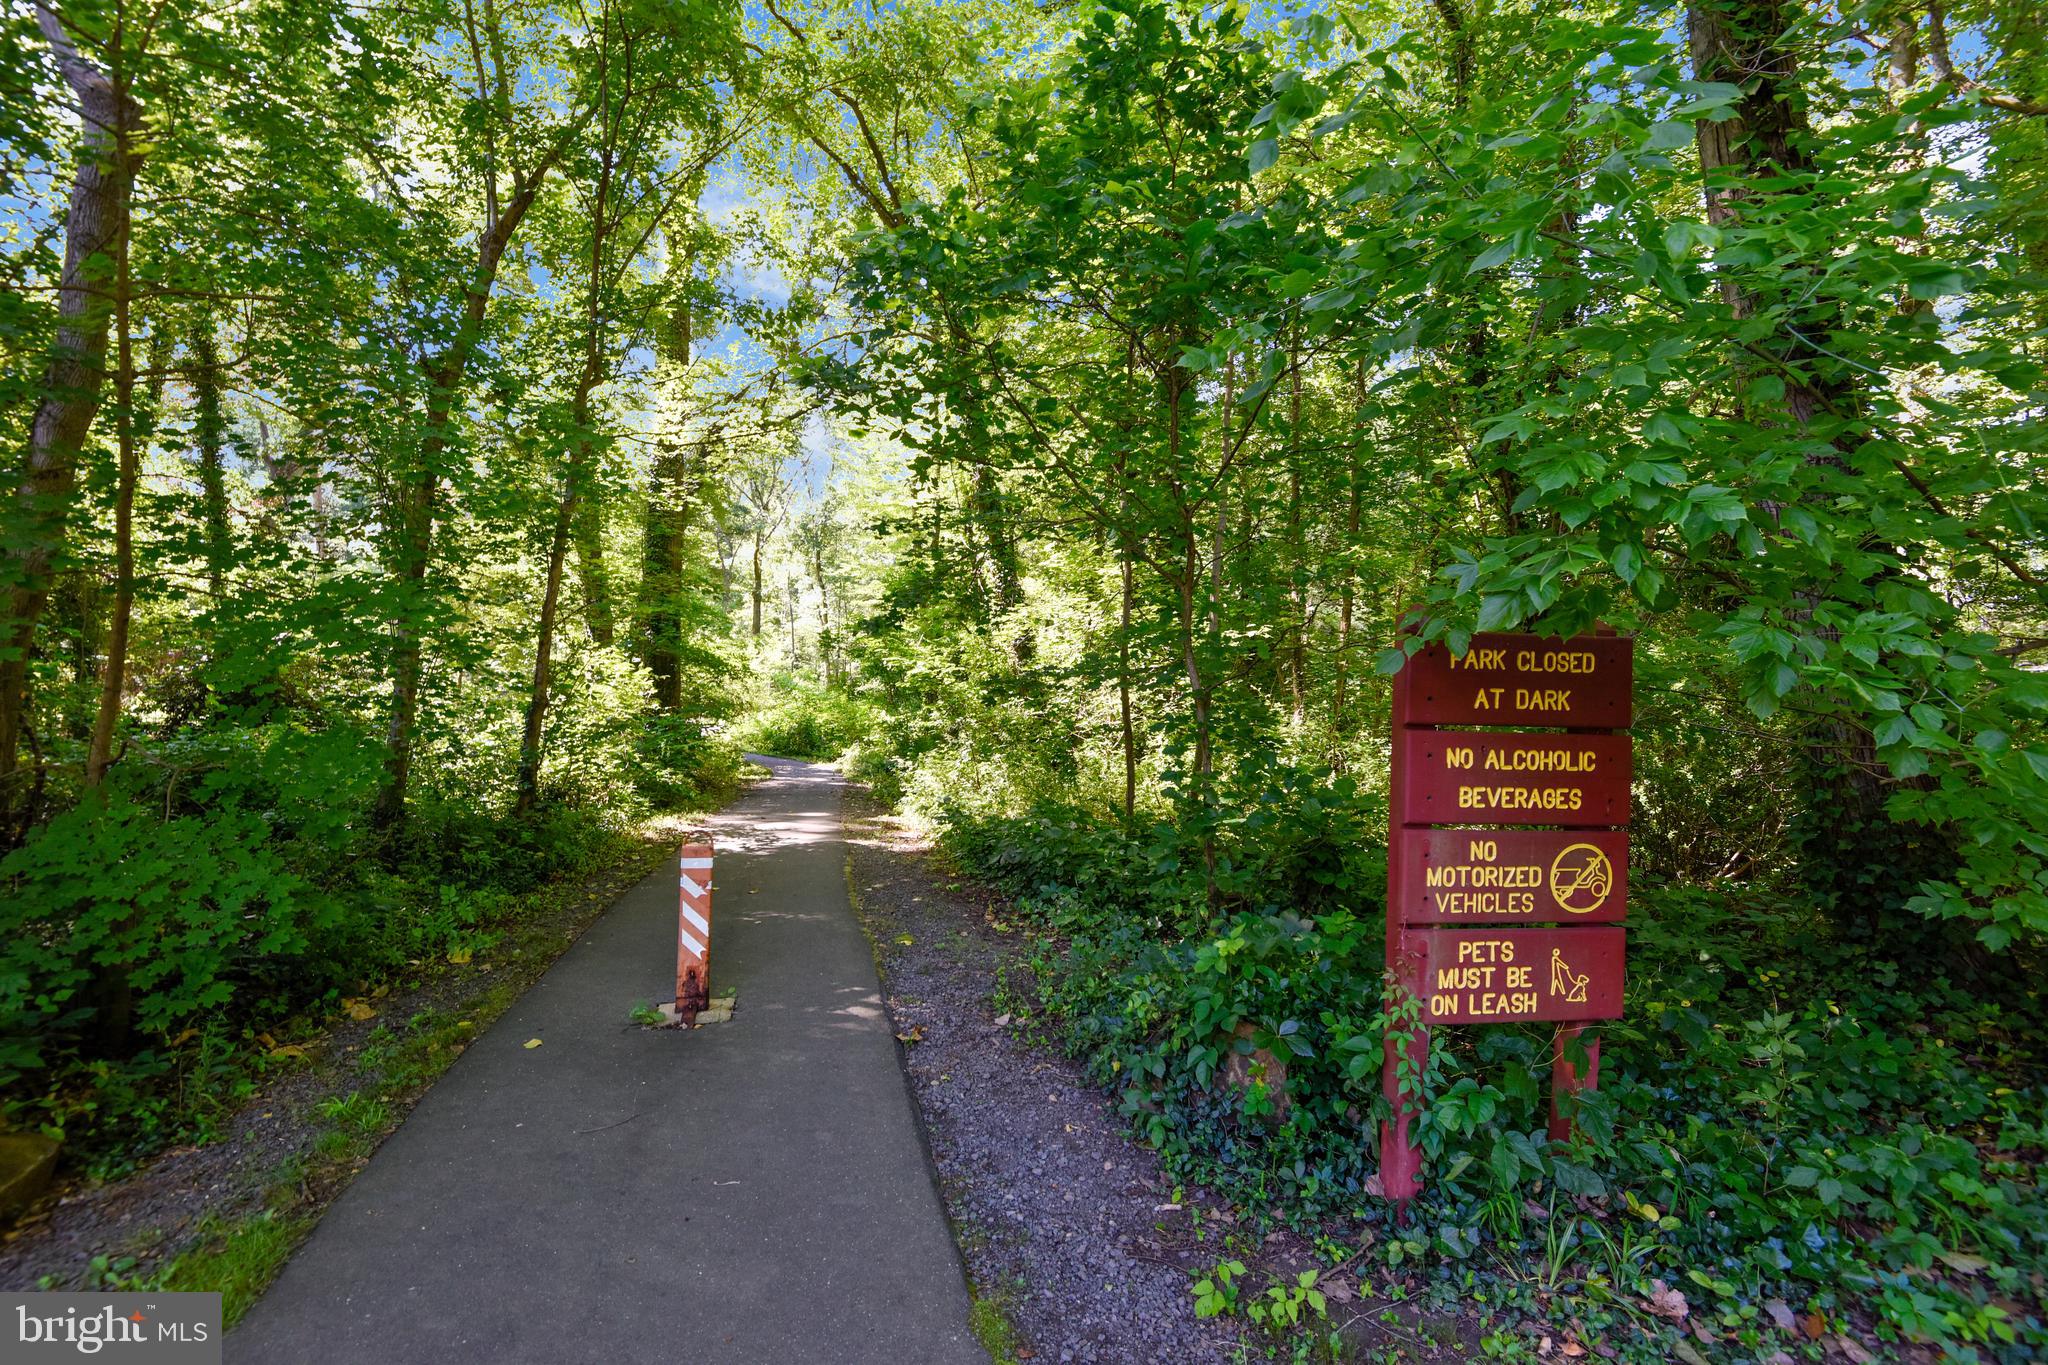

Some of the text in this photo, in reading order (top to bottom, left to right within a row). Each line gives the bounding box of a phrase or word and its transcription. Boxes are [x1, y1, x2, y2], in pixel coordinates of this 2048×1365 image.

[1450, 649, 1595, 673] PARK CLOSED
[1473, 688, 1571, 711] AT DARK
[1446, 747, 1596, 772] NO ALCOHOLIC
[1459, 786, 1582, 810] BEVERAGES
[1470, 840, 1496, 862] NO
[1426, 866, 1542, 888] MOTORIZED
[1435, 893, 1534, 913] VEHICLES
[1459, 941, 1514, 963] PETS
[1438, 967, 1532, 989] MUST BE
[1431, 993, 1537, 1016] ON LEASH
